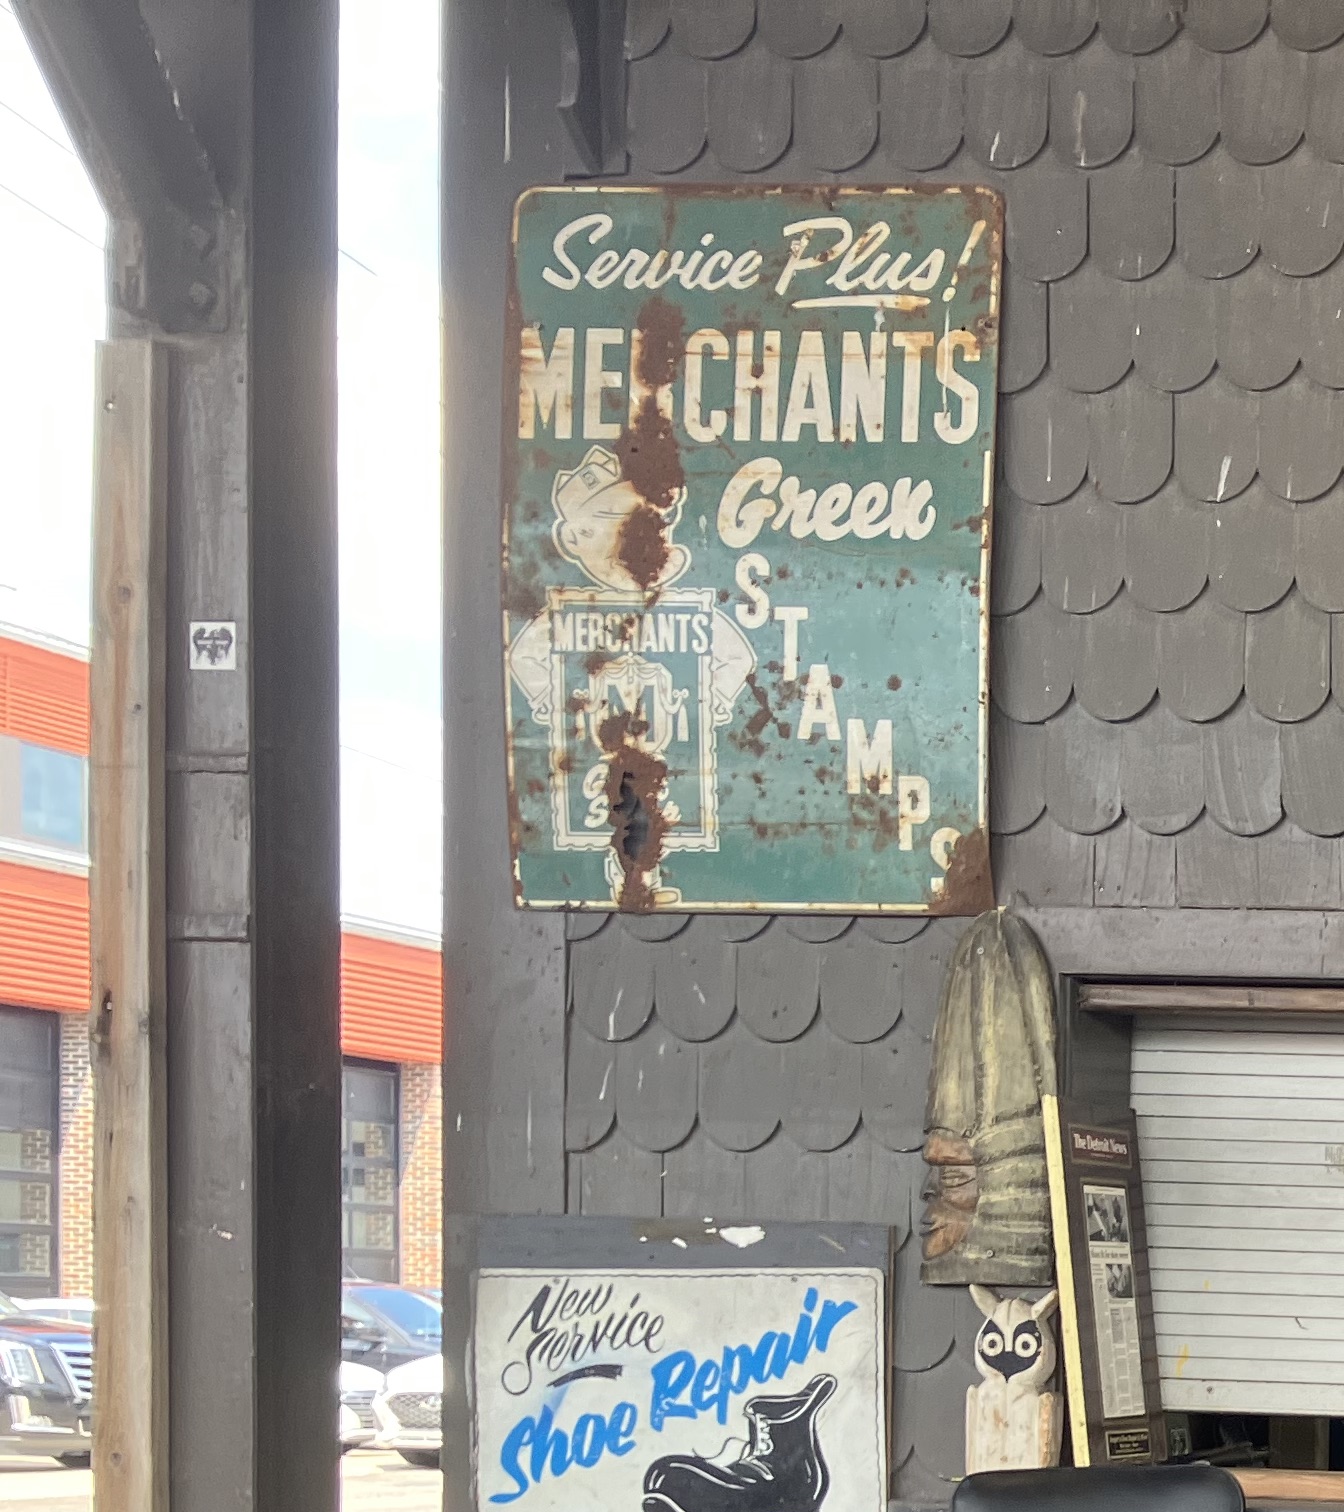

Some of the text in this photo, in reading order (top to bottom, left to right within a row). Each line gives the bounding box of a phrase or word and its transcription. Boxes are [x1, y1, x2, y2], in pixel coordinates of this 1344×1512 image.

[542, 213, 986, 302] Service Plus!
[717, 456, 937, 548] Green
[502, 1293, 665, 1396] Service
[507, 1278, 613, 1344] New
[488, 1287, 859, 1504] Shoe Repair
